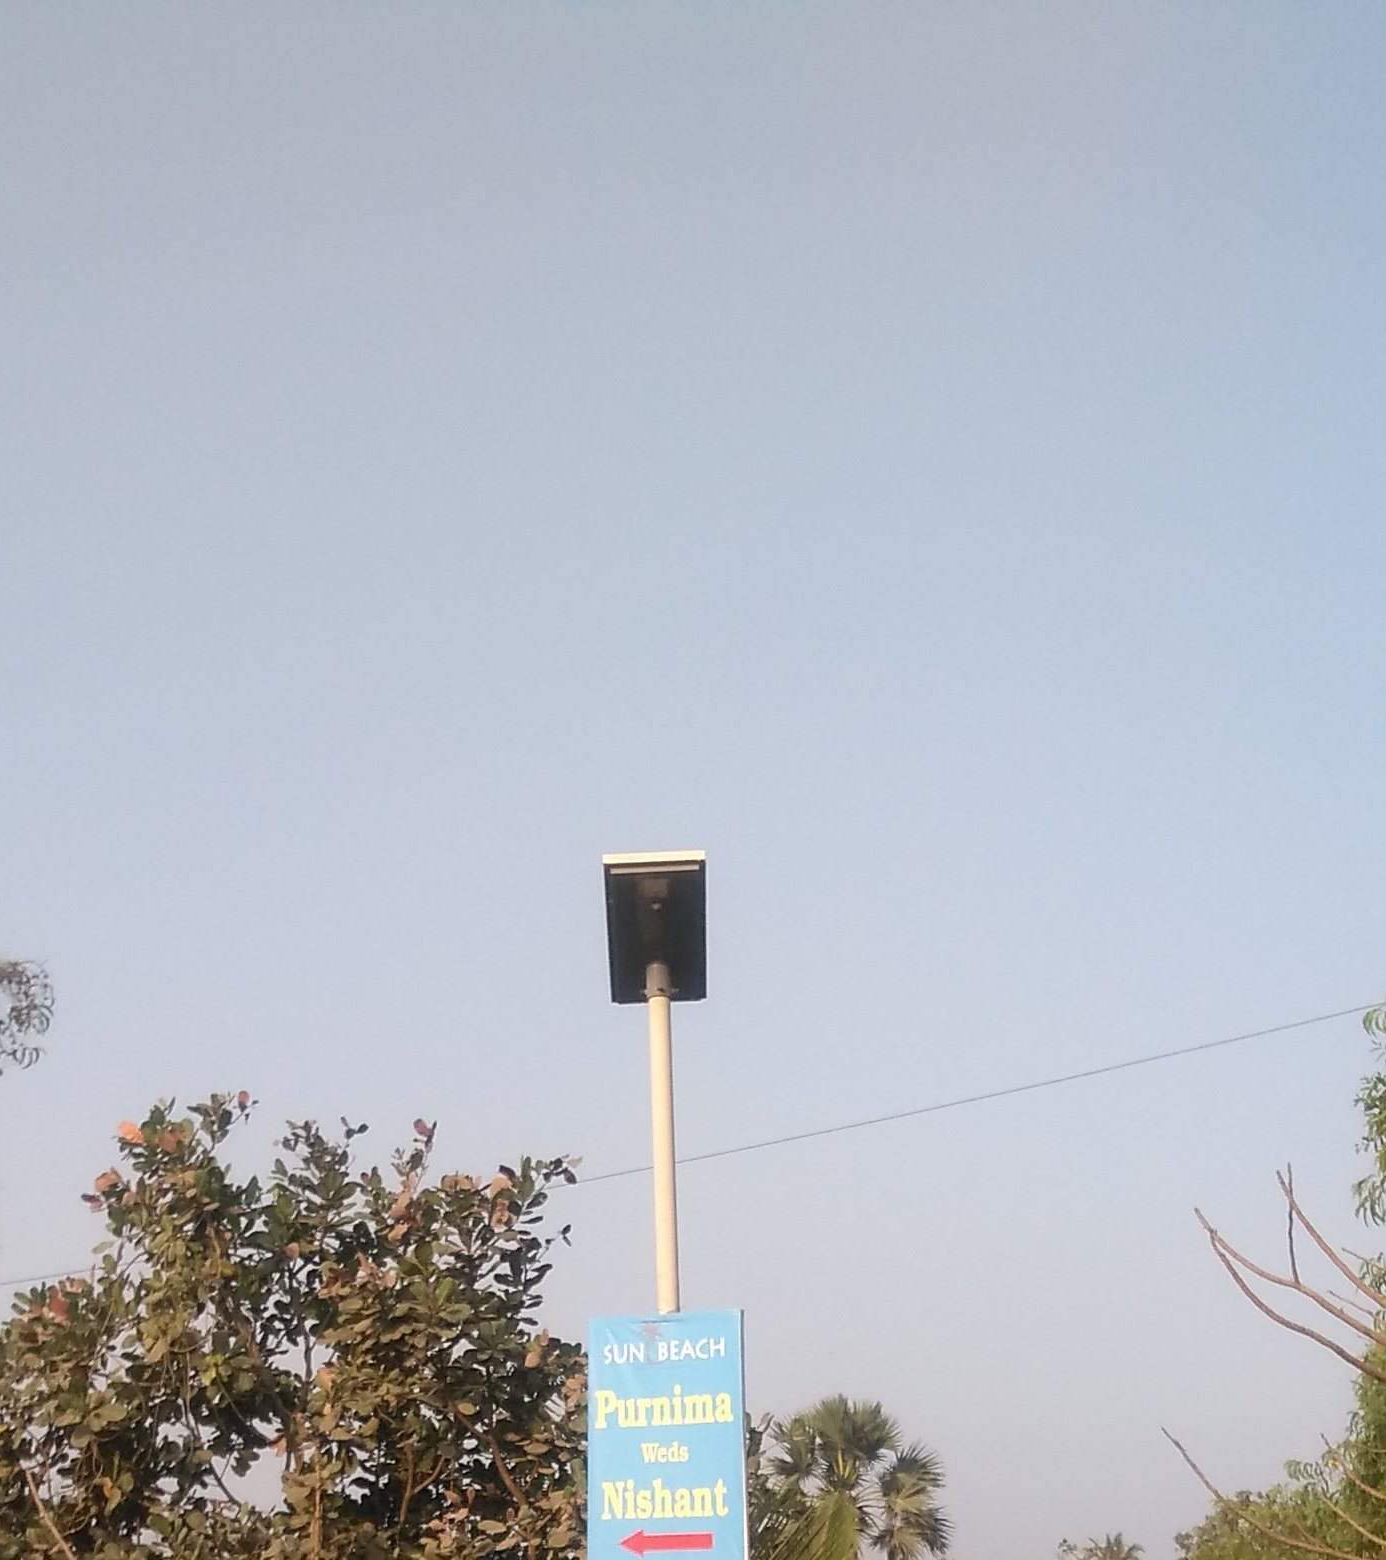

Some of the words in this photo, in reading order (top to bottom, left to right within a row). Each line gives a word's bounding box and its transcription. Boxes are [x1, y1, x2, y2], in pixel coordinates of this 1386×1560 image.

[604, 1342, 644, 1364] SUN
[658, 1338, 726, 1361] BEACH
[595, 1385, 733, 1429] Purnima
[641, 1442, 689, 1463] Weds
[601, 1478, 729, 1520] Nishant
